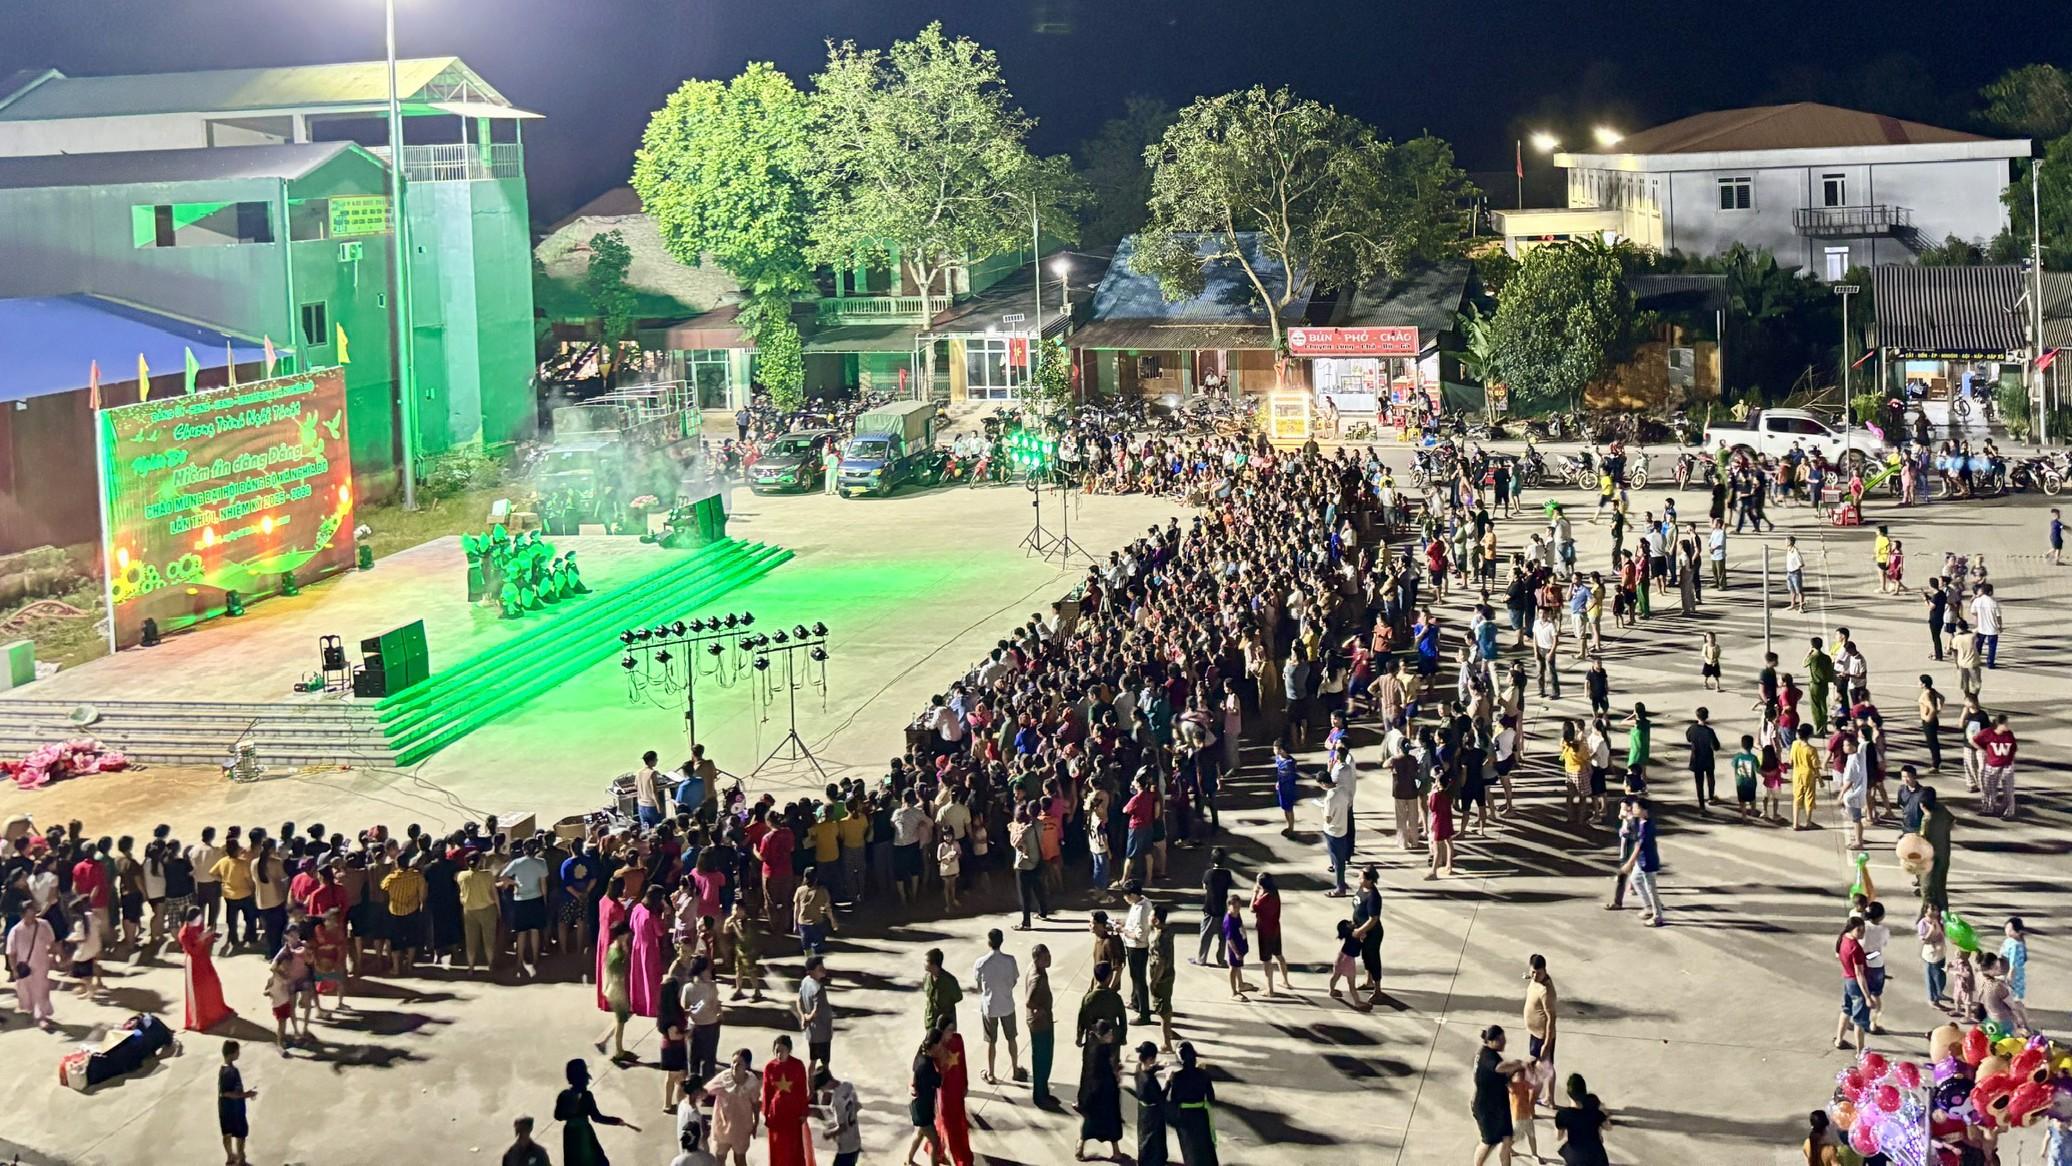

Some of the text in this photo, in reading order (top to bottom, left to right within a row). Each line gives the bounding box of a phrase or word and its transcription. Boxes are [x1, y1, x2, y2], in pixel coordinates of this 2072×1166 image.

[1308, 331, 1332, 342] BÚN
[1343, 330, 1369, 342] PHỞ
[173, 462, 210, 487] Niềm
[268, 443, 303, 465] Đảng
[1990, 742, 2013, 757] W
